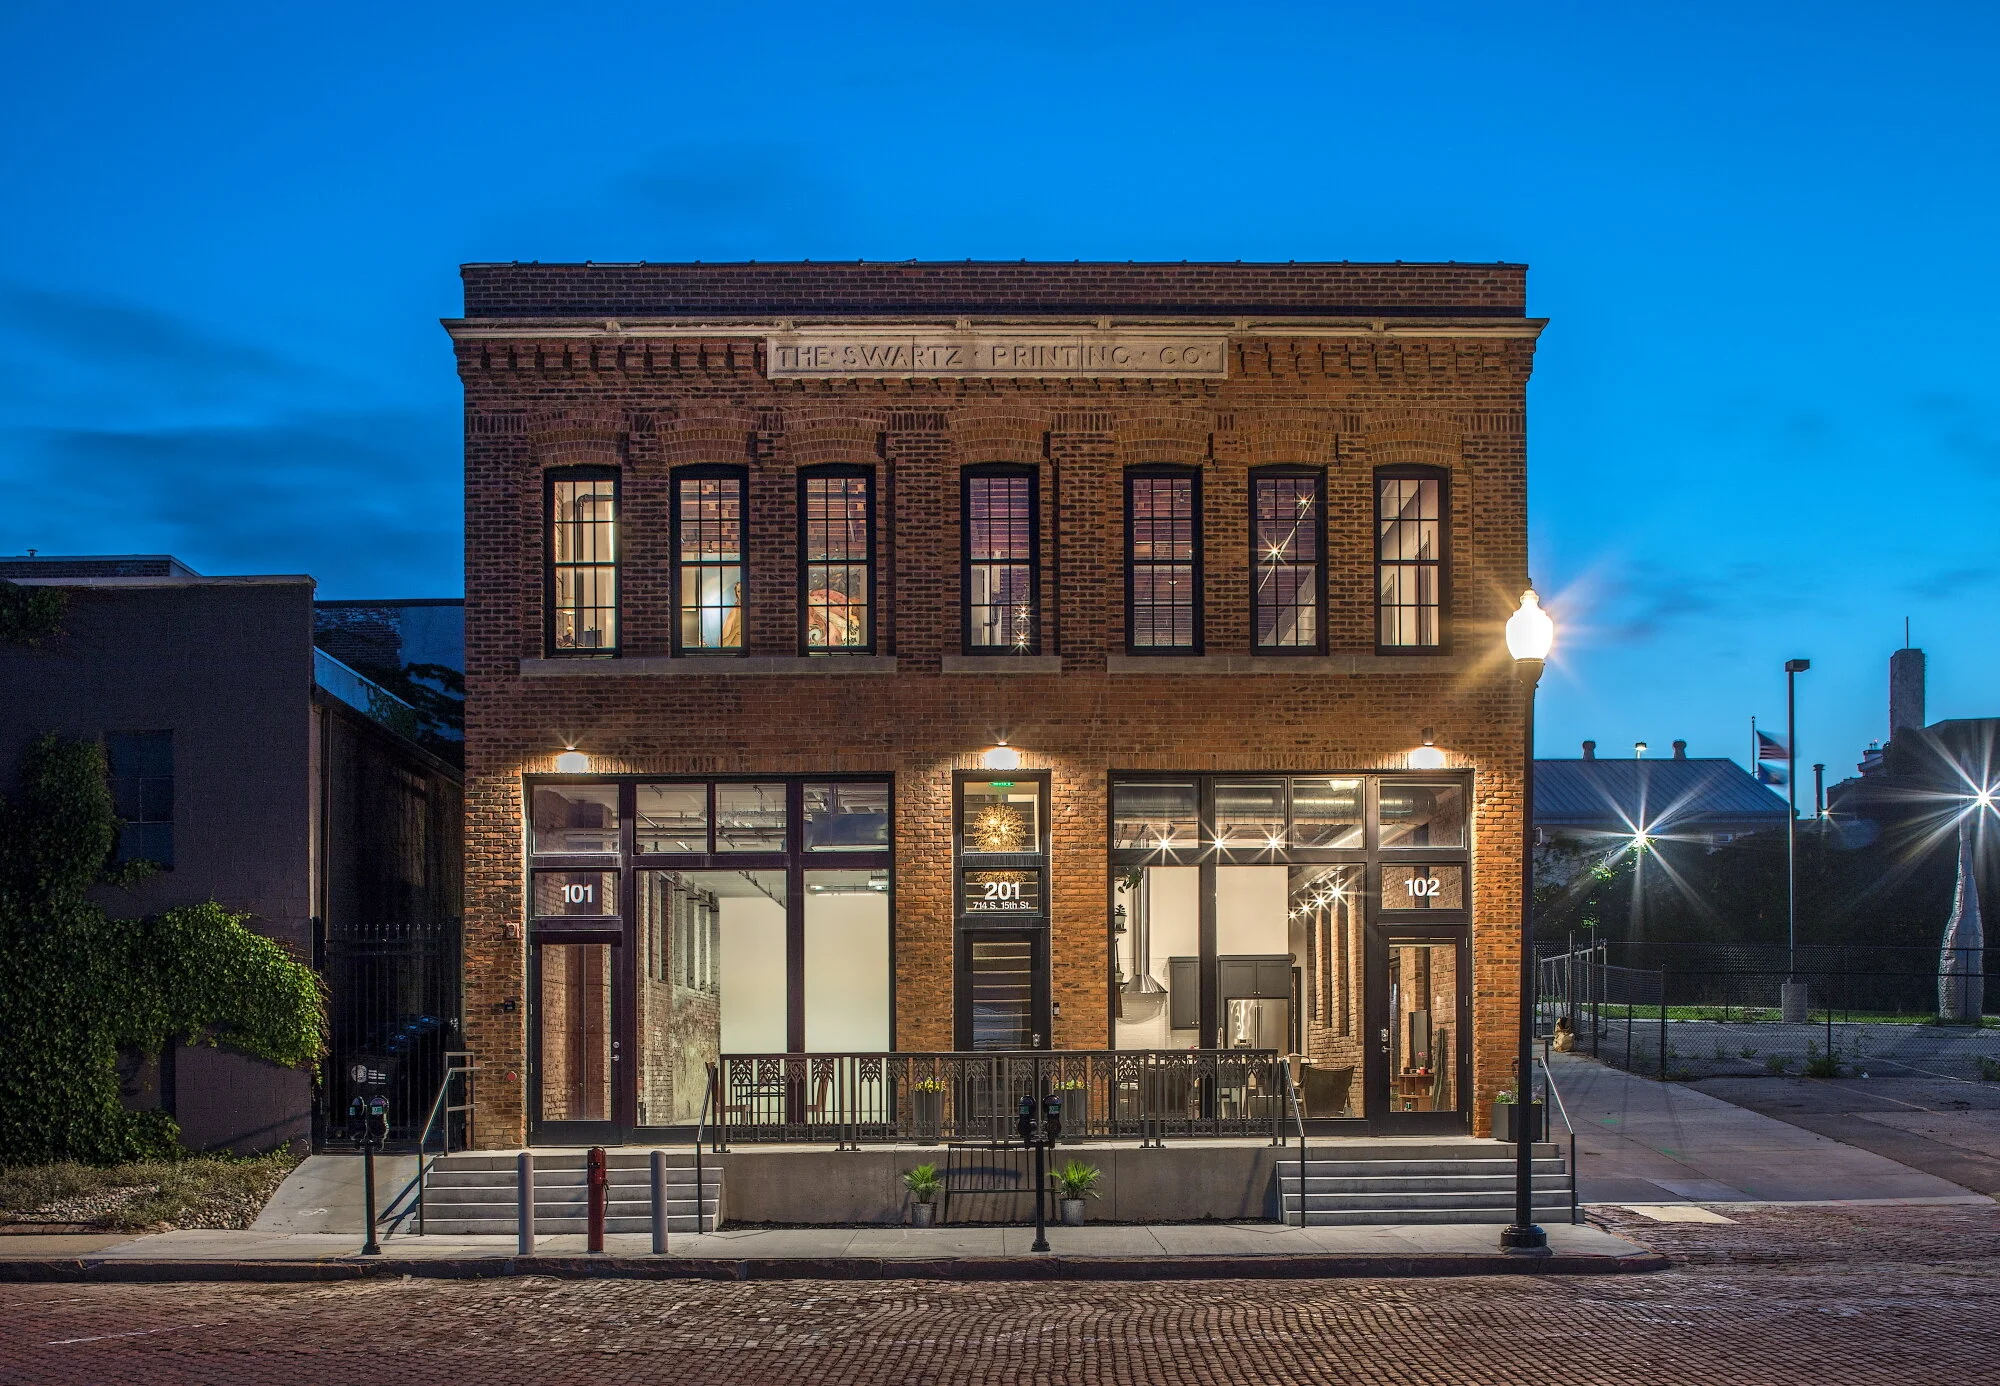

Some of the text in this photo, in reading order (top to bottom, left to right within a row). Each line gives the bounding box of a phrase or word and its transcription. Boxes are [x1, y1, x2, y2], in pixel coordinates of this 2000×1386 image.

[776, 346, 831, 367] THE
[842, 346, 965, 368] SWARTZ
[992, 346, 1132, 367] PRINTING
[560, 884, 593, 904] 101
[984, 881, 1020, 901] 201
[1404, 877, 1440, 897] 102
[972, 901, 1031, 910] 714 S. 15th St.
